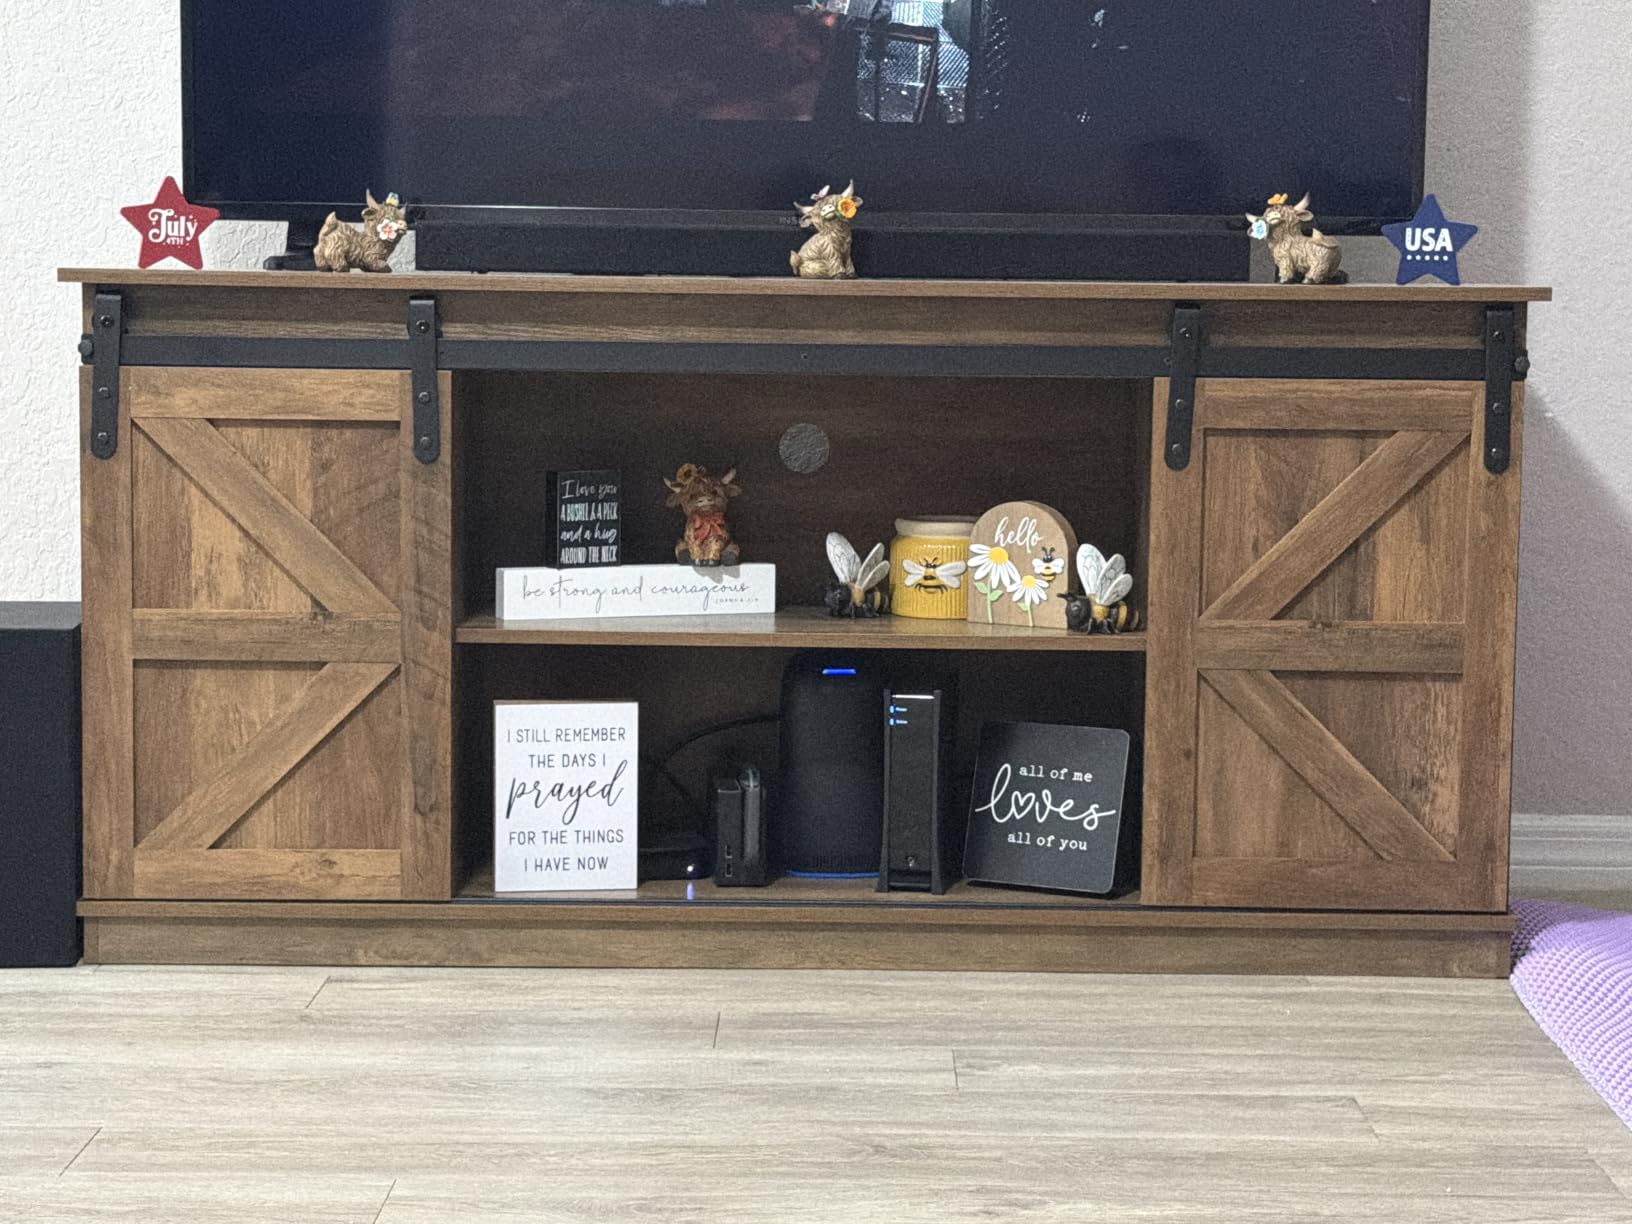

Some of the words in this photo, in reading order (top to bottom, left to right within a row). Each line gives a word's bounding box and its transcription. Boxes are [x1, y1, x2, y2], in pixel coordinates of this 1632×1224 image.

[148, 208, 198, 243] July
[1405, 227, 1453, 252] USA
[561, 479, 575, 499] I
[575, 480, 596, 497] love
[598, 484, 618, 499] you
[560, 503, 566, 521] A
[566, 502, 589, 521] BUSHEL
[603, 502, 618, 520] PECK
[560, 524, 583, 543] and
[584, 529, 592, 540] a
[594, 521, 617, 544] hug
[994, 516, 1044, 553] hello
[560, 546, 587, 565] AROUND
[588, 545, 600, 564] THE
[601, 545, 618, 562] NECK
[522, 575, 545, 600] be
[549, 575, 607, 614] strong
[611, 576, 643, 600] and
[651, 582, 750, 612] courageous
[507, 729, 511, 743] I
[516, 729, 551, 743] STILL
[555, 727, 627, 742] REMEMBER
[528, 754, 556, 768] THE
[561, 753, 597, 768] DAYS
[602, 753, 606, 767] I
[1019, 765, 1045, 778] all
[1049, 768, 1069, 781] of
[1071, 771, 1094, 783] me
[505, 759, 628, 826] prayed
[974, 763, 1117, 831] loves
[509, 831, 537, 846] FOR
[542, 830, 568, 845] THE
[574, 829, 624, 844] THINGS
[1007, 832, 1032, 845] all
[1036, 835, 1056, 848] of
[1058, 838, 1088, 851] you
[524, 859, 528, 873] I
[534, 857, 571, 873] HAVE
[577, 856, 609, 871] NOW
